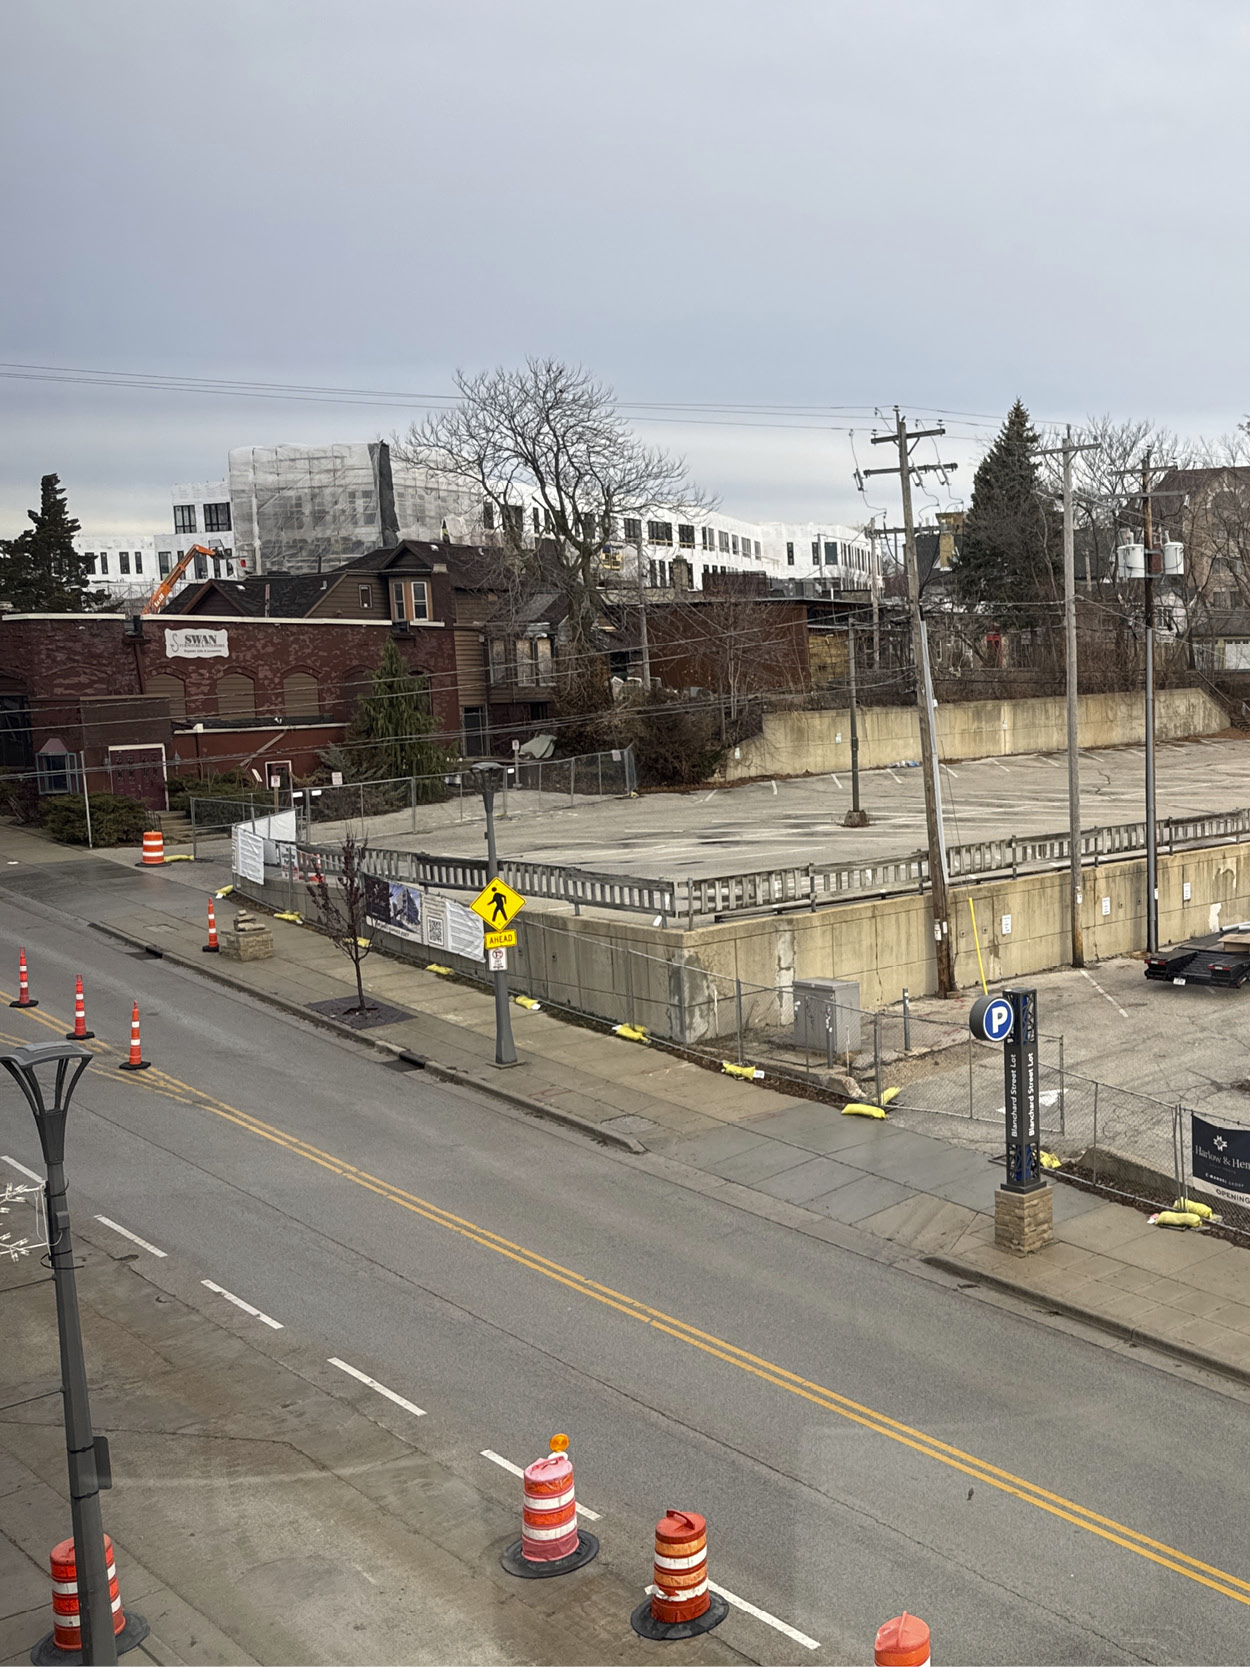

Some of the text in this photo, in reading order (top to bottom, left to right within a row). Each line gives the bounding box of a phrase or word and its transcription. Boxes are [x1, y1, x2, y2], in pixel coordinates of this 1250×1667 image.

[184, 634, 217, 644] SWAN
[490, 934, 513, 944] AHEAD
[992, 1006, 1008, 1034] P
[1195, 1145, 1222, 1163] Harlow
[1223, 1156, 1231, 1166] &
[1216, 1188, 1250, 1205] OPENING
